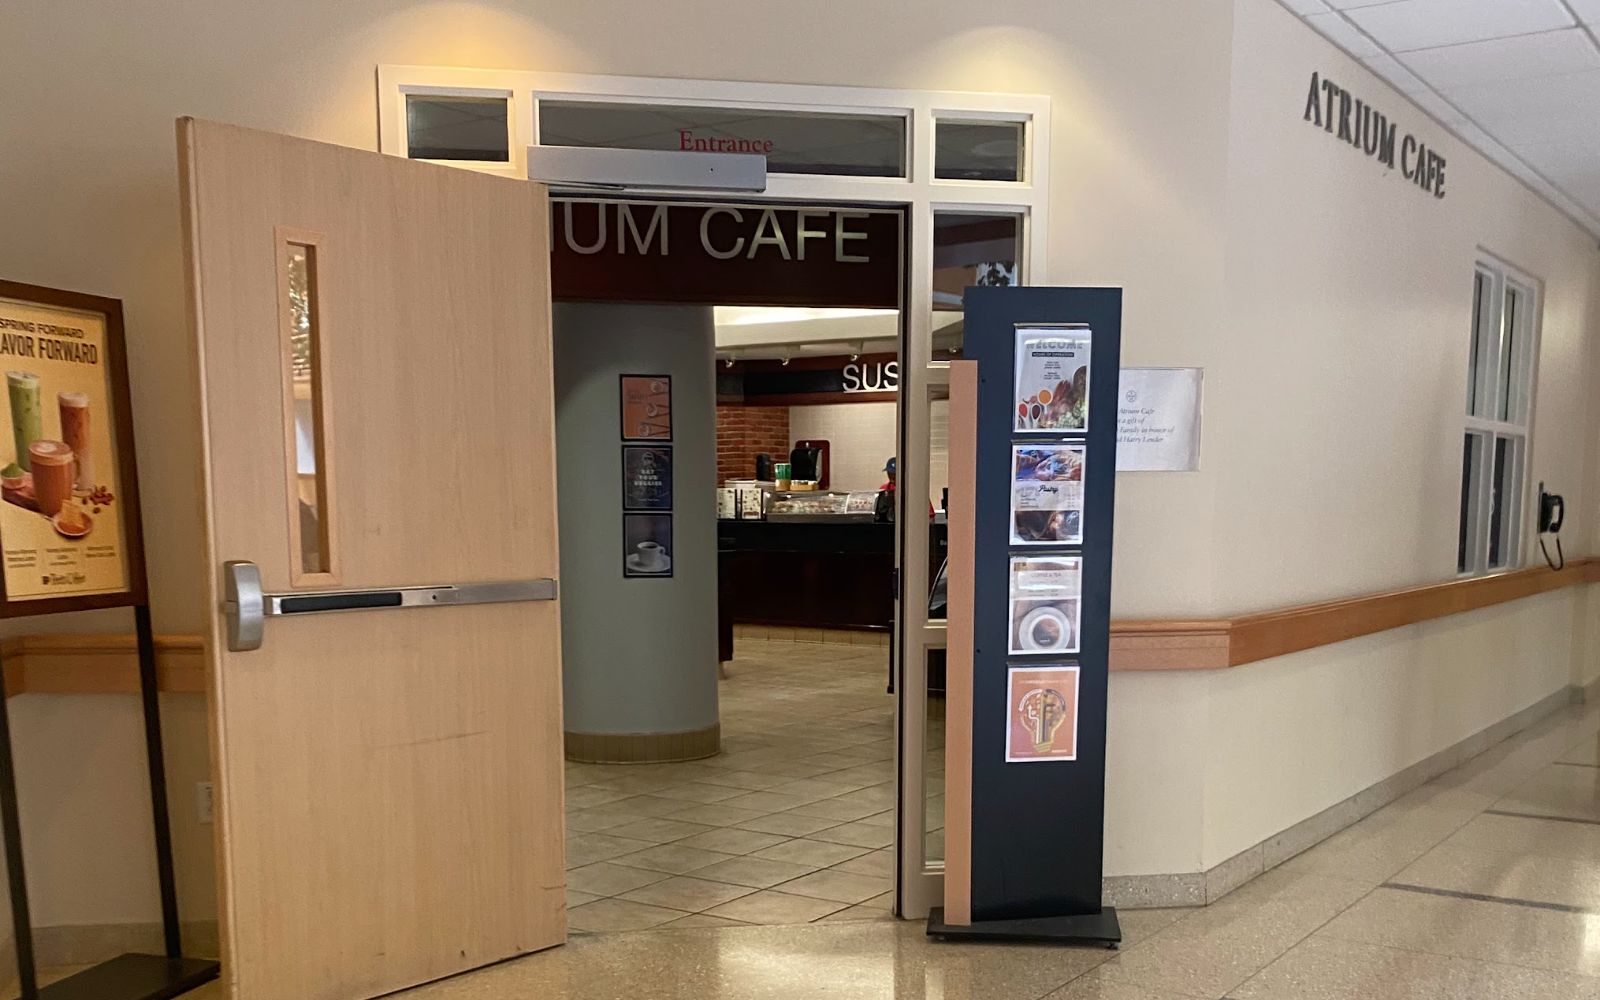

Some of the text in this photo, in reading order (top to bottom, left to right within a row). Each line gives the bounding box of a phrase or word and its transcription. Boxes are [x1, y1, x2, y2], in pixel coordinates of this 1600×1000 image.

[678, 128, 774, 153] Entrance
[1303, 71, 1447, 200] ATRIUM CAFE
[699, 206, 870, 263] CAFE
[38, 324, 84, 339] FORWARD
[38, 337, 98, 364] FORWARD
[842, 361, 898, 391] SUS
